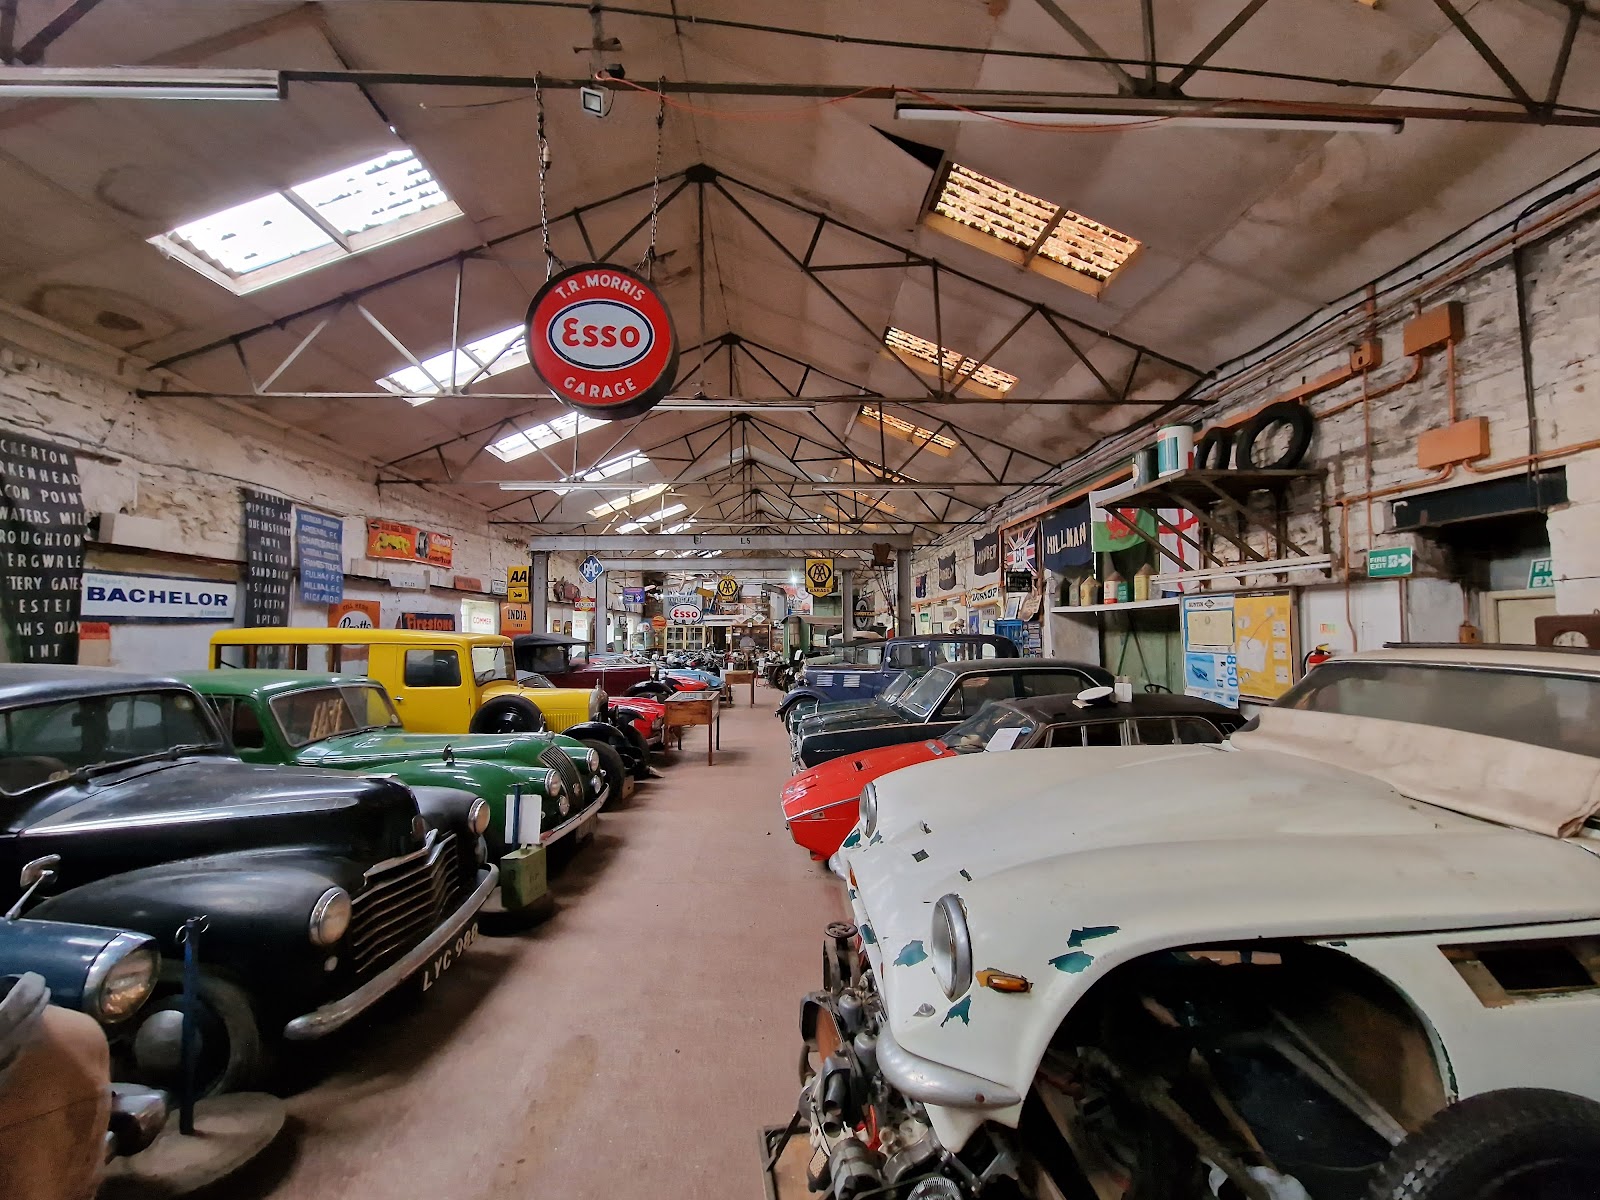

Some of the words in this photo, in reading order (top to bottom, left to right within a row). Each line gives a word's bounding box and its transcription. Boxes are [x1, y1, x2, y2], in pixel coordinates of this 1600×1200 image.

[585, 274, 646, 301] MORRIS
[564, 376, 637, 398] GARAGE
[60, 512, 87, 525] MIL
[1046, 522, 1087, 555] HILLMAN
[583, 559, 599, 578] RAC
[1369, 562, 1387, 570] EXIT
[510, 570, 527, 583] AA
[87, 586, 229, 607] BACHELOR
[404, 613, 454, 631] Firestone
[507, 608, 527, 620] INDIA
[423, 949, 452, 991] LYC
[455, 922, 479, 957] 988
